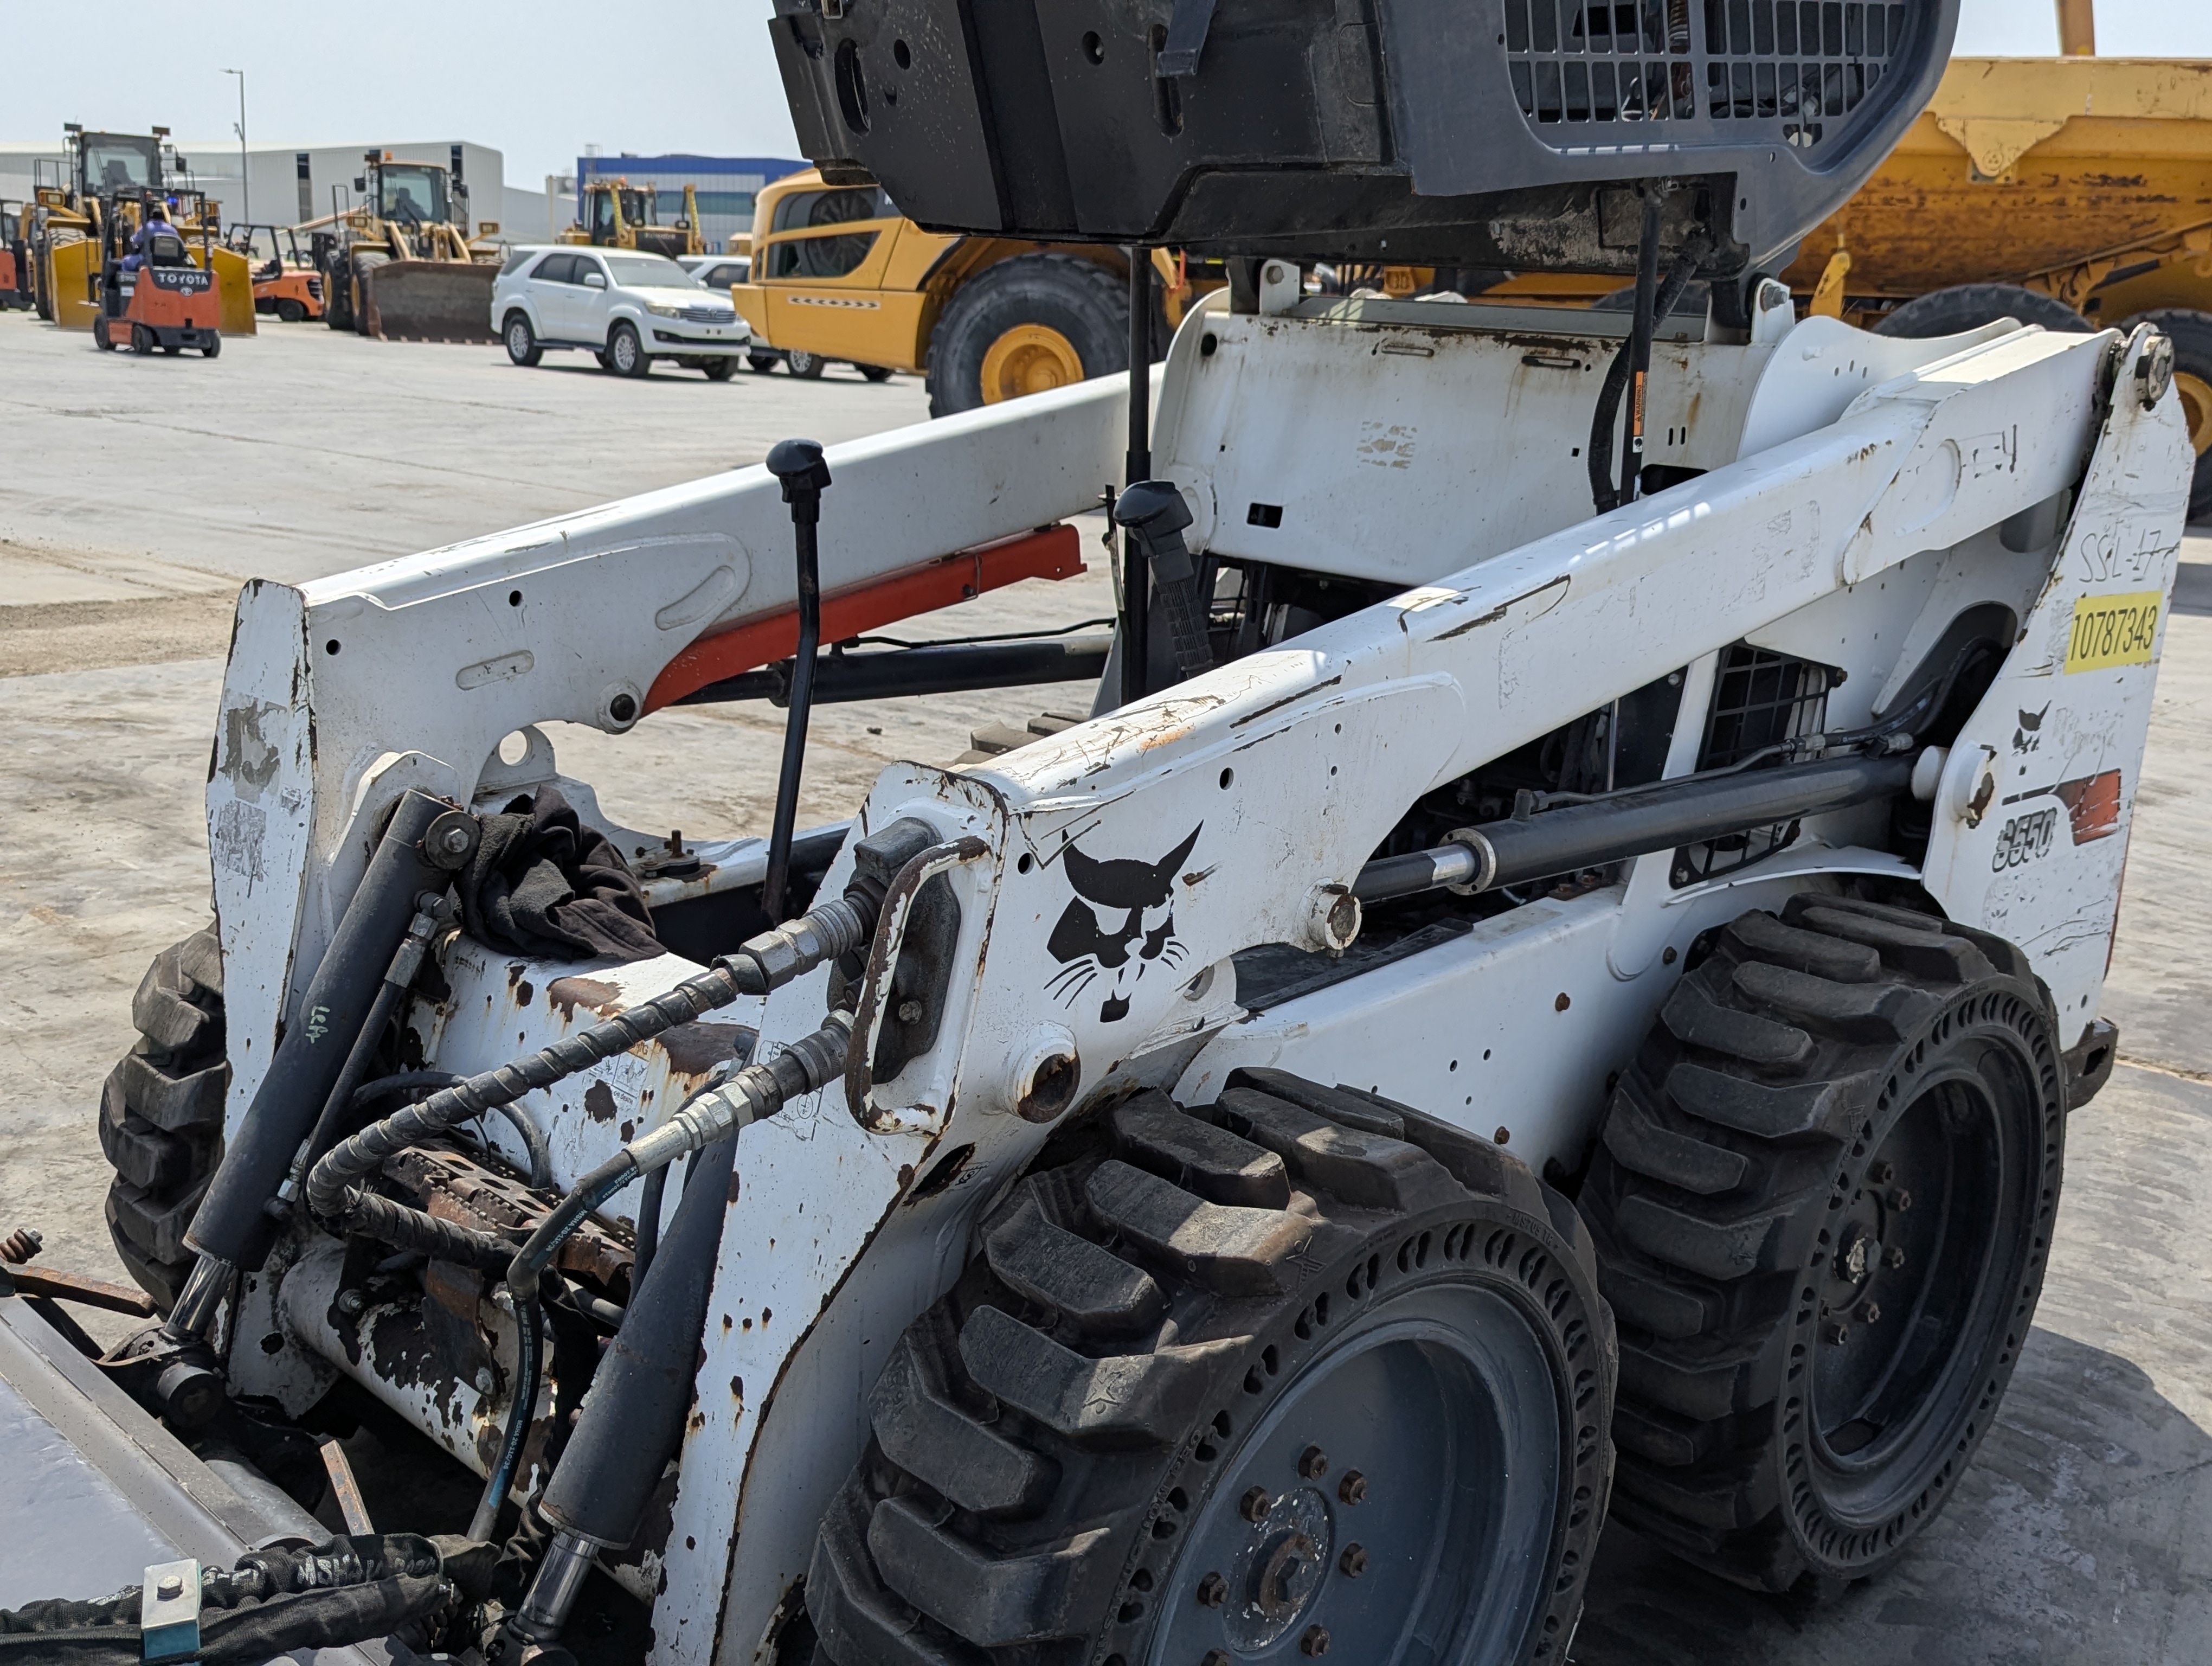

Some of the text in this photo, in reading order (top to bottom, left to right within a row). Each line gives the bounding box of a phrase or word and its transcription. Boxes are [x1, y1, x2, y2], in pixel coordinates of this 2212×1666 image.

[158, 272, 209, 285] TOYOTA
[2070, 605, 2157, 661] 10787343
[1992, 806, 2057, 873] S550
